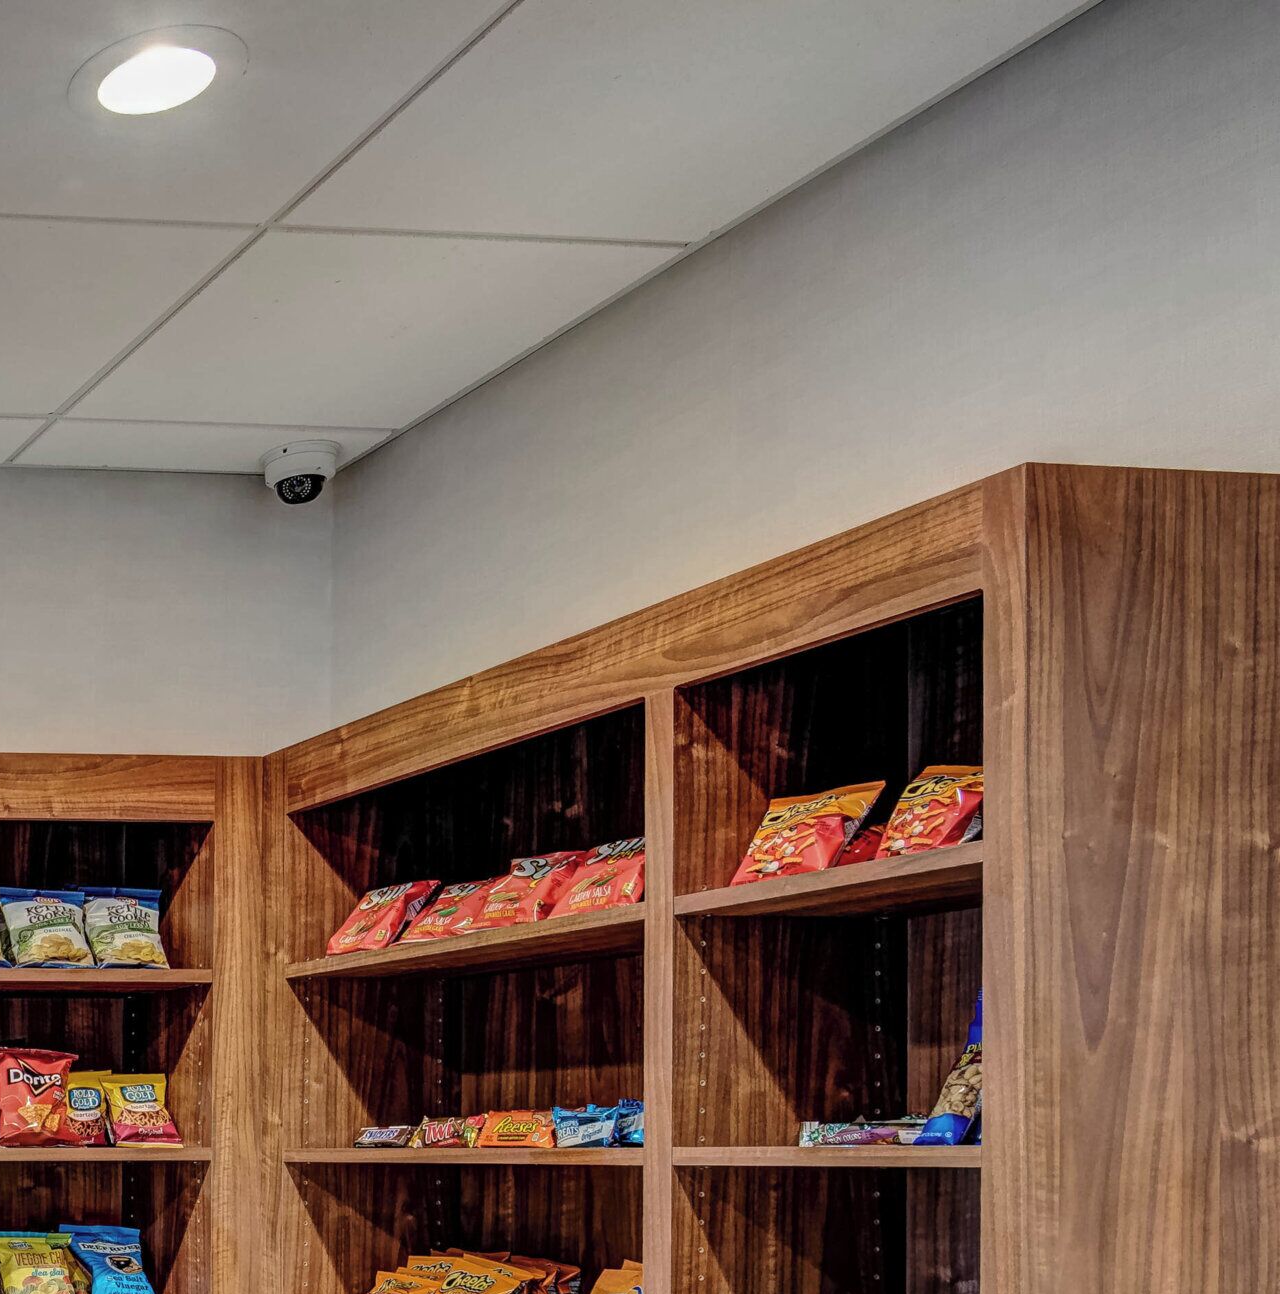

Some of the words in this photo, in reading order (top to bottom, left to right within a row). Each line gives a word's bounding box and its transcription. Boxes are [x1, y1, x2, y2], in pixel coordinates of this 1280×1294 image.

[74, 1088, 95, 1098] ROLD
[126, 1085, 153, 1093] ROLD
[126, 1091, 156, 1101] GOLD
[71, 1097, 99, 1109] GOLD
[493, 1116, 538, 1134] Reese's
[138, 1128, 164, 1136] Original
[364, 1129, 399, 1140] SNICKERS
[557, 1126, 579, 1138] REATS
[81, 1243, 109, 1251] DEEP
[13, 1252, 47, 1266] VEGGIE
[31, 1269, 49, 1277] Sea
[441, 1271, 496, 1292] Cheetos
[115, 1282, 149, 1292] Vinegar
